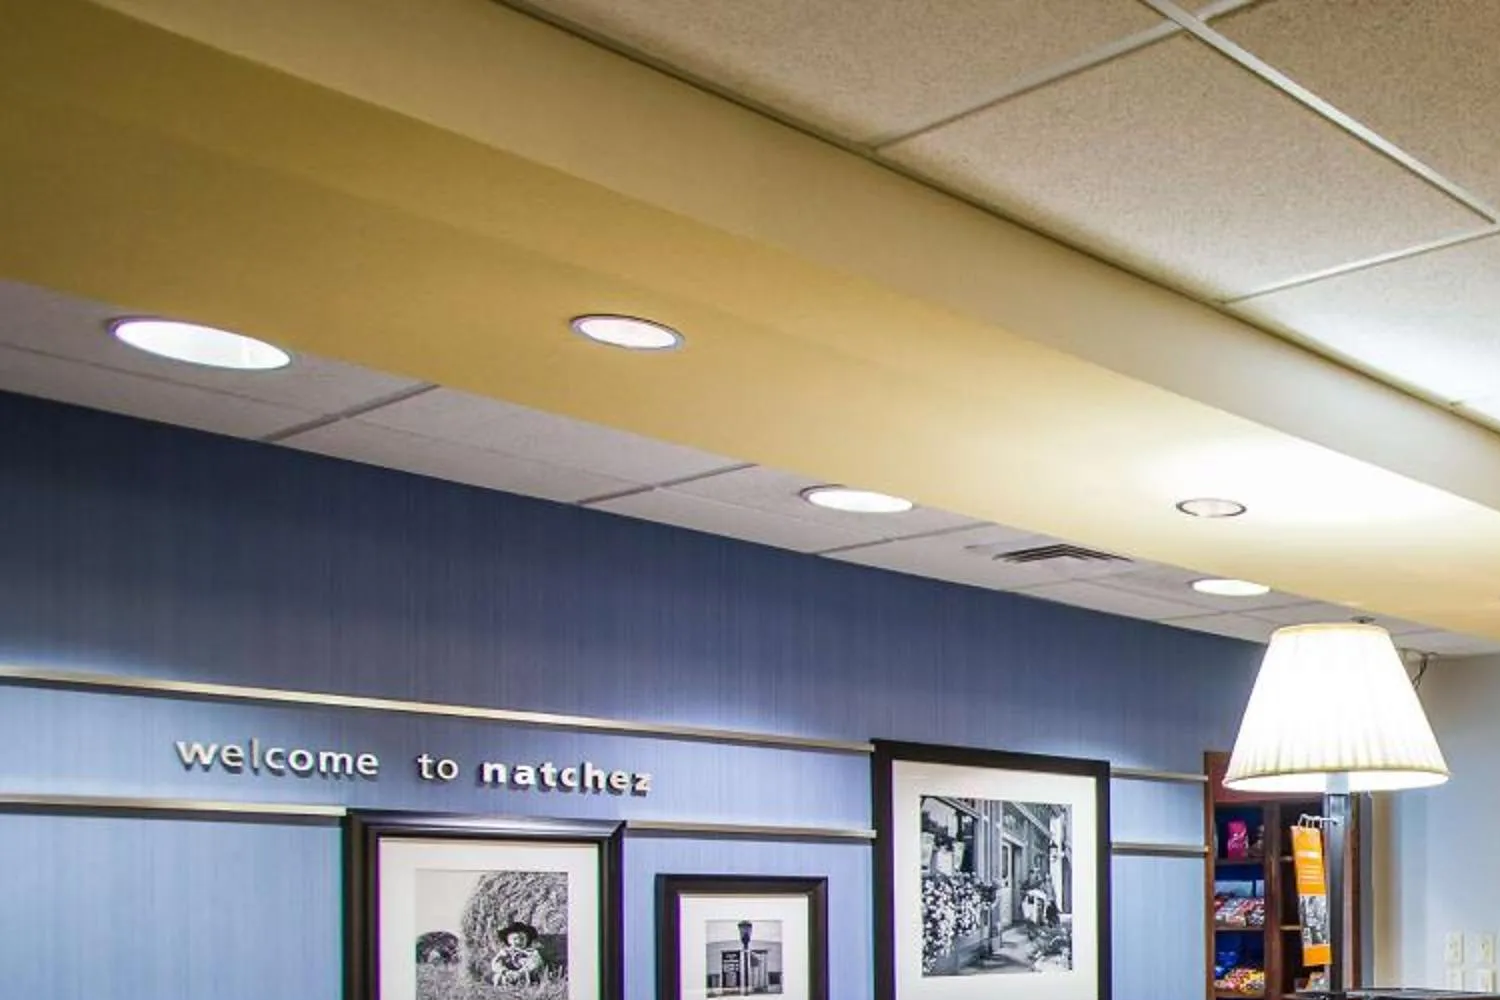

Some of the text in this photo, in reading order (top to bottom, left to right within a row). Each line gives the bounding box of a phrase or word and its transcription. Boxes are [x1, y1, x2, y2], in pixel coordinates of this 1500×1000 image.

[175, 736, 653, 795] welcome to natchez
